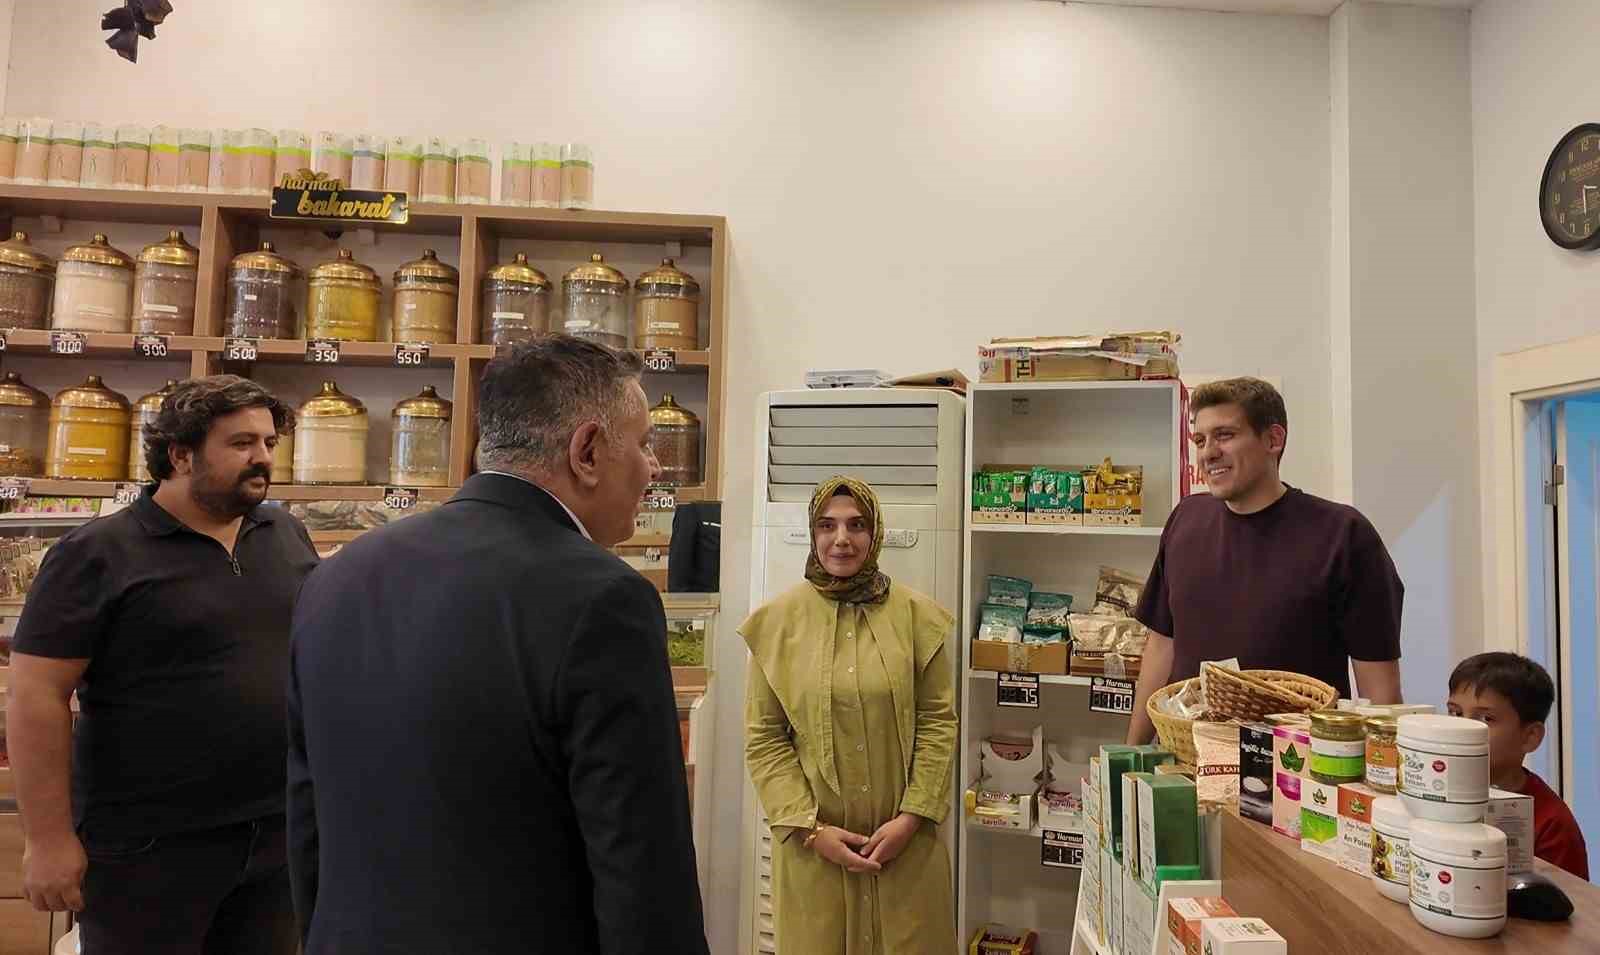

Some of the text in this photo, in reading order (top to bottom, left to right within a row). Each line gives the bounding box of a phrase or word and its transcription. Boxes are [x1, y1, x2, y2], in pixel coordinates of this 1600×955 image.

[1105, 679, 1133, 689] Harman
[1021, 688, 1038, 704] 75
[1056, 831, 1083, 843] Harman
